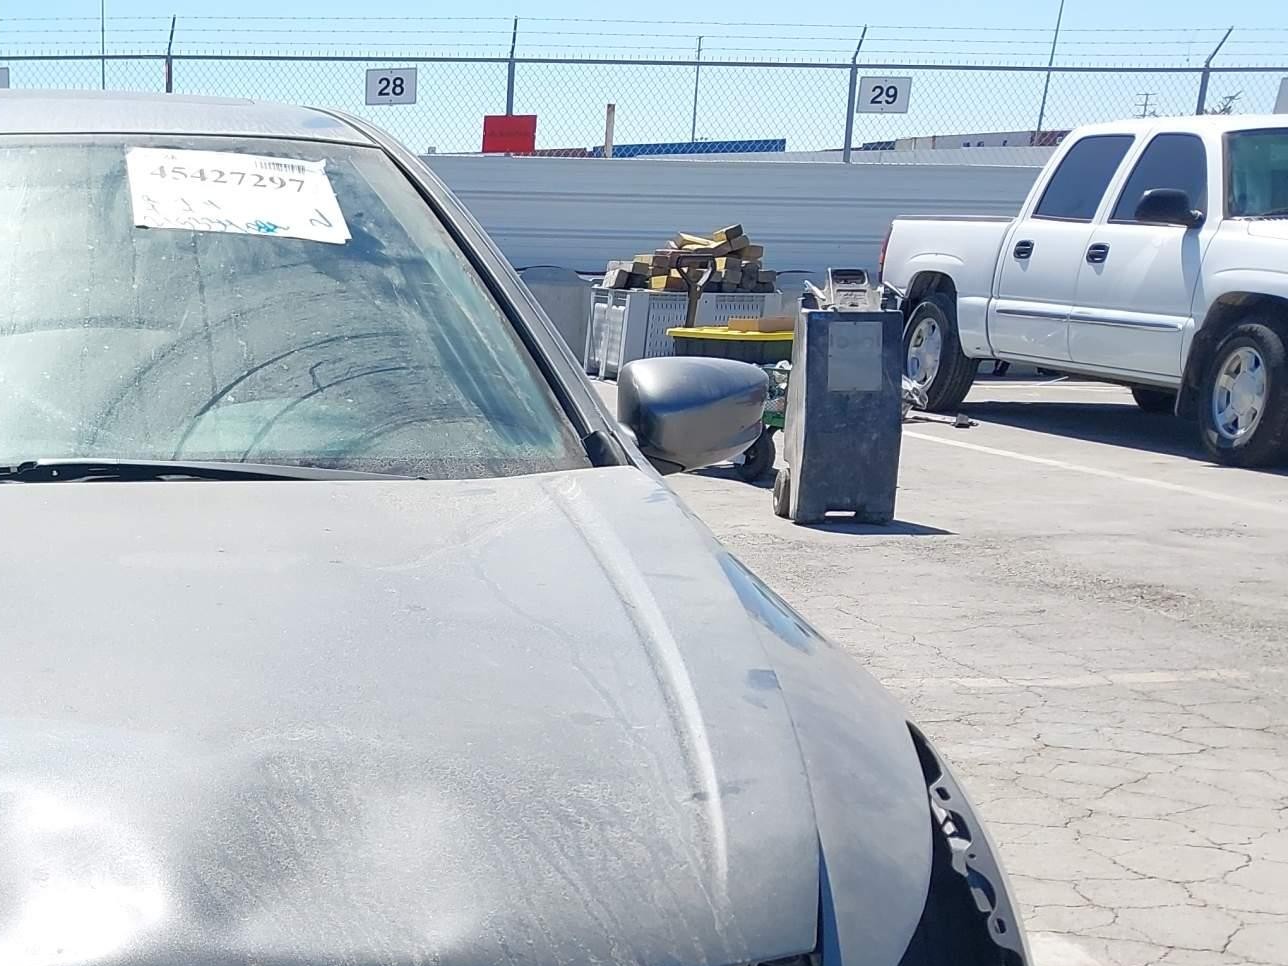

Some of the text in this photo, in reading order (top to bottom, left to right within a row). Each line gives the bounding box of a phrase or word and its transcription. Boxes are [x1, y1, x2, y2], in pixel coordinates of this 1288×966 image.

[377, 77, 405, 96] 28
[869, 85, 899, 105] 29
[149, 165, 306, 193] 45427297
